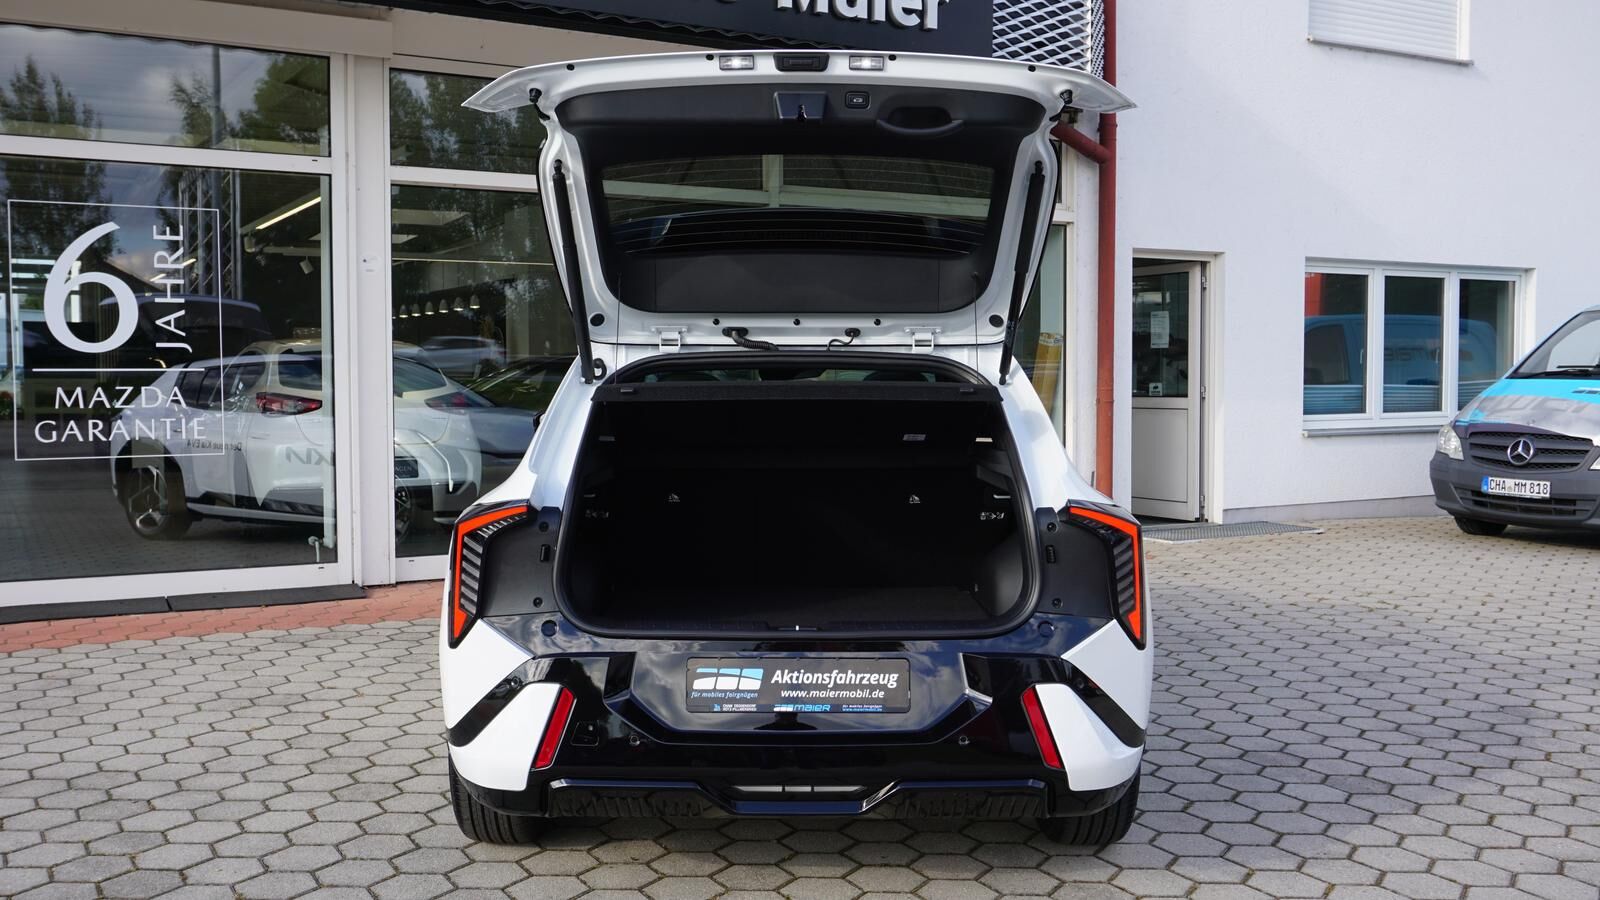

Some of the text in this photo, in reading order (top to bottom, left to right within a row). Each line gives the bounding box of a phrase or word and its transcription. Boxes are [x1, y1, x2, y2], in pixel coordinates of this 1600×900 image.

[44, 221, 139, 353] 6
[153, 225, 192, 353] JAHRE
[55, 386, 188, 409] MAZDA
[34, 418, 207, 443] GARANTIE
[1489, 479, 1548, 495] CHA MM 818
[771, 669, 899, 688] Aktionsfahrzeug
[781, 688, 885, 698] www.maiermobil.de
